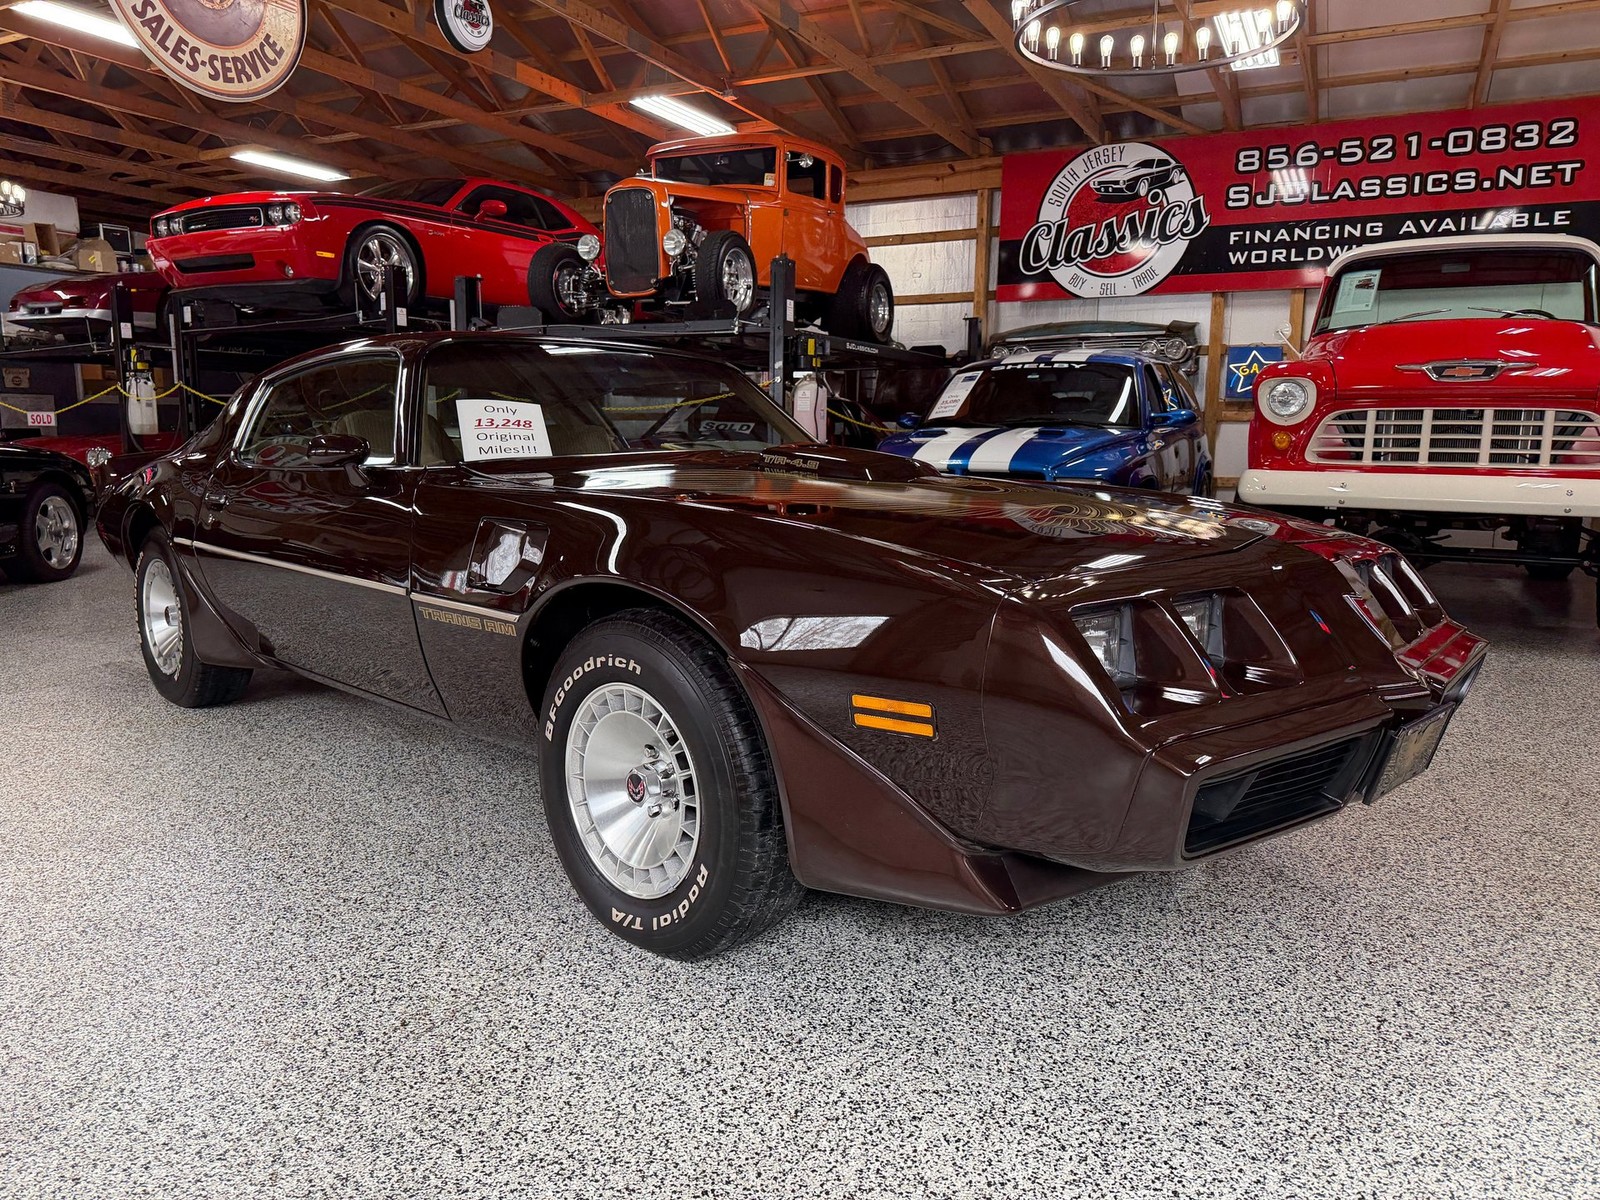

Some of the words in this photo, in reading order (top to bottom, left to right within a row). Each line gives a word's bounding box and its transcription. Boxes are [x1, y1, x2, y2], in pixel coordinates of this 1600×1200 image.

[454, 3, 490, 27] Classics
[131, 1, 285, 84] SALES-SERVICE
[1236, 119, 1577, 173] 856-521-0832
[1047, 167, 1081, 208] SOUTH
[1082, 145, 1126, 174] JERSEY
[1227, 162, 1582, 208] SJCLASSICS.NET
[1019, 189, 1211, 276] Classics
[1229, 222, 1384, 246] FINANCING
[1398, 210, 1572, 235] AVAILABLE
[1228, 244, 1358, 265] WORLDW
[1068, 272, 1088, 291] BUY
[1099, 282, 1118, 296] SELL
[1131, 266, 1160, 290] TRADE
[991, 363, 1087, 371] SHELBY
[31, 414, 52, 425] SOLD
[474, 417, 534, 430] 13,248
[484, 405, 518, 415] Only
[476, 432, 535, 443] Original
[702, 421, 751, 432] SOLD
[479, 445, 538, 455] Miles!!!
[419, 606, 482, 630] TRANS
[484, 619, 517, 637] AM
[545, 654, 642, 742] BFGoodrich
[653, 863, 709, 931] Radial
[611, 907, 644, 931] T/A
